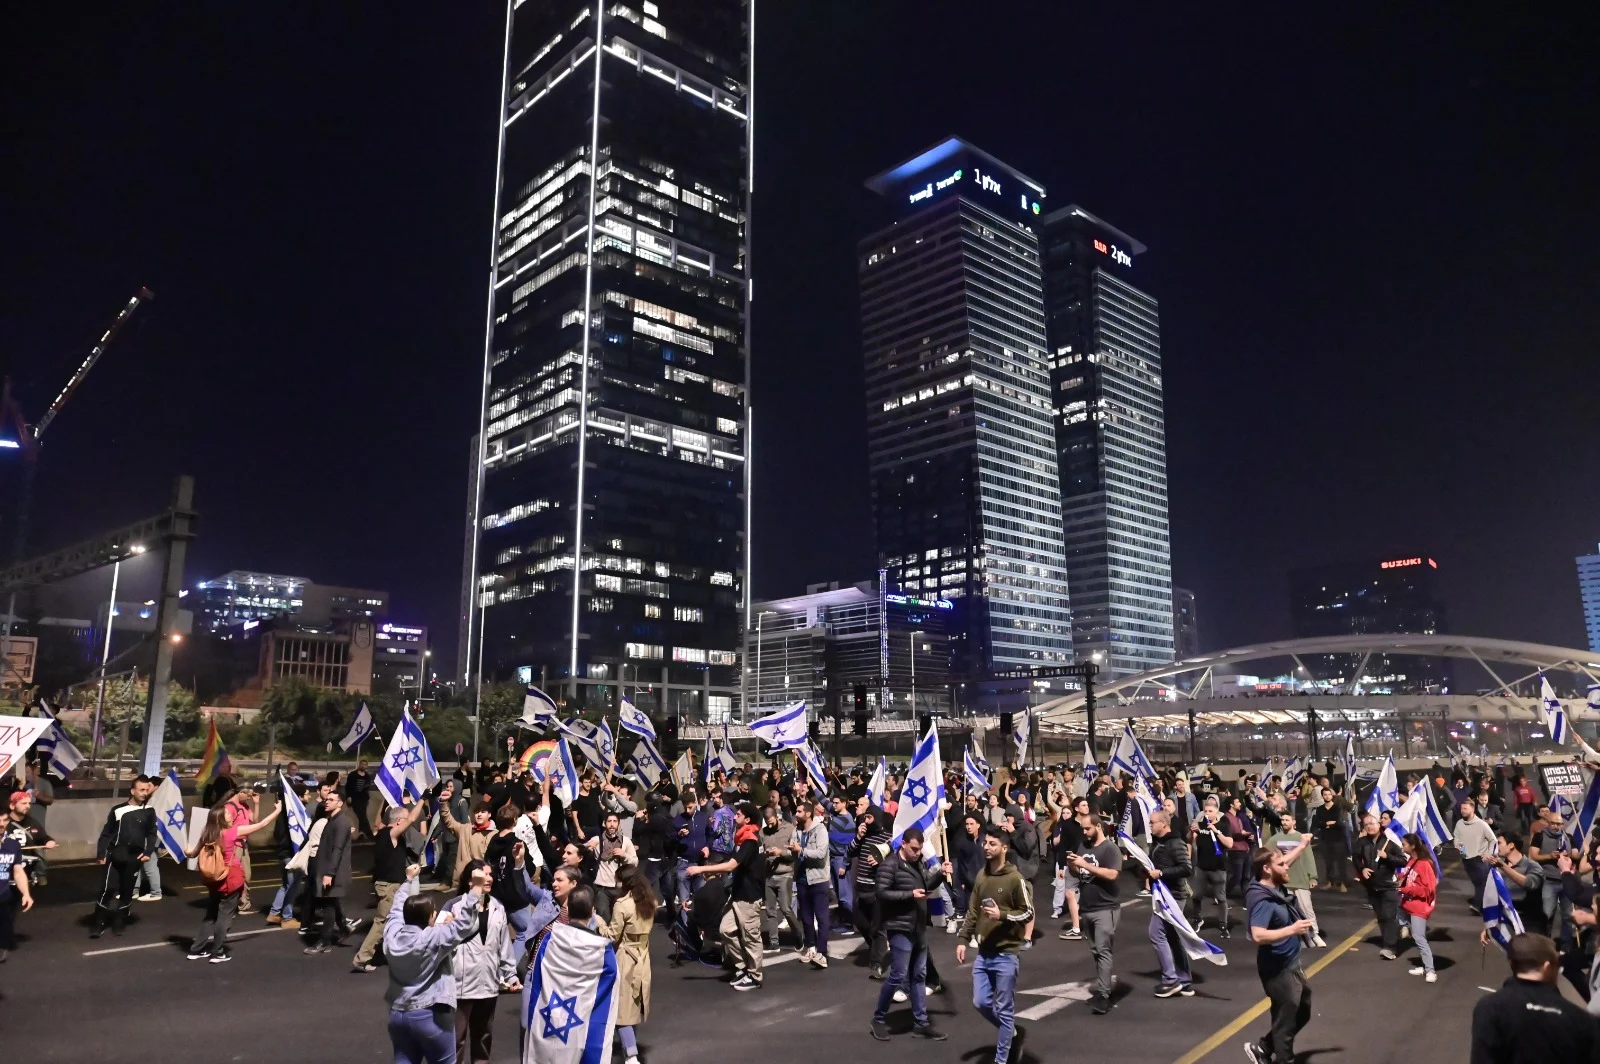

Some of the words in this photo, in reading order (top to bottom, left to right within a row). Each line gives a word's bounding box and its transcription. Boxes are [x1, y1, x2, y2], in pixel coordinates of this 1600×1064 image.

[974, 168, 982, 185] 1
[982, 174, 1002, 196] אלון
[1111, 245, 1117, 259] 2
[1117, 250, 1132, 267] אלון
[1381, 558, 1422, 569] SUZUKI
[1567, 765, 1578, 775] אין
[1570, 775, 1581, 783] עם
